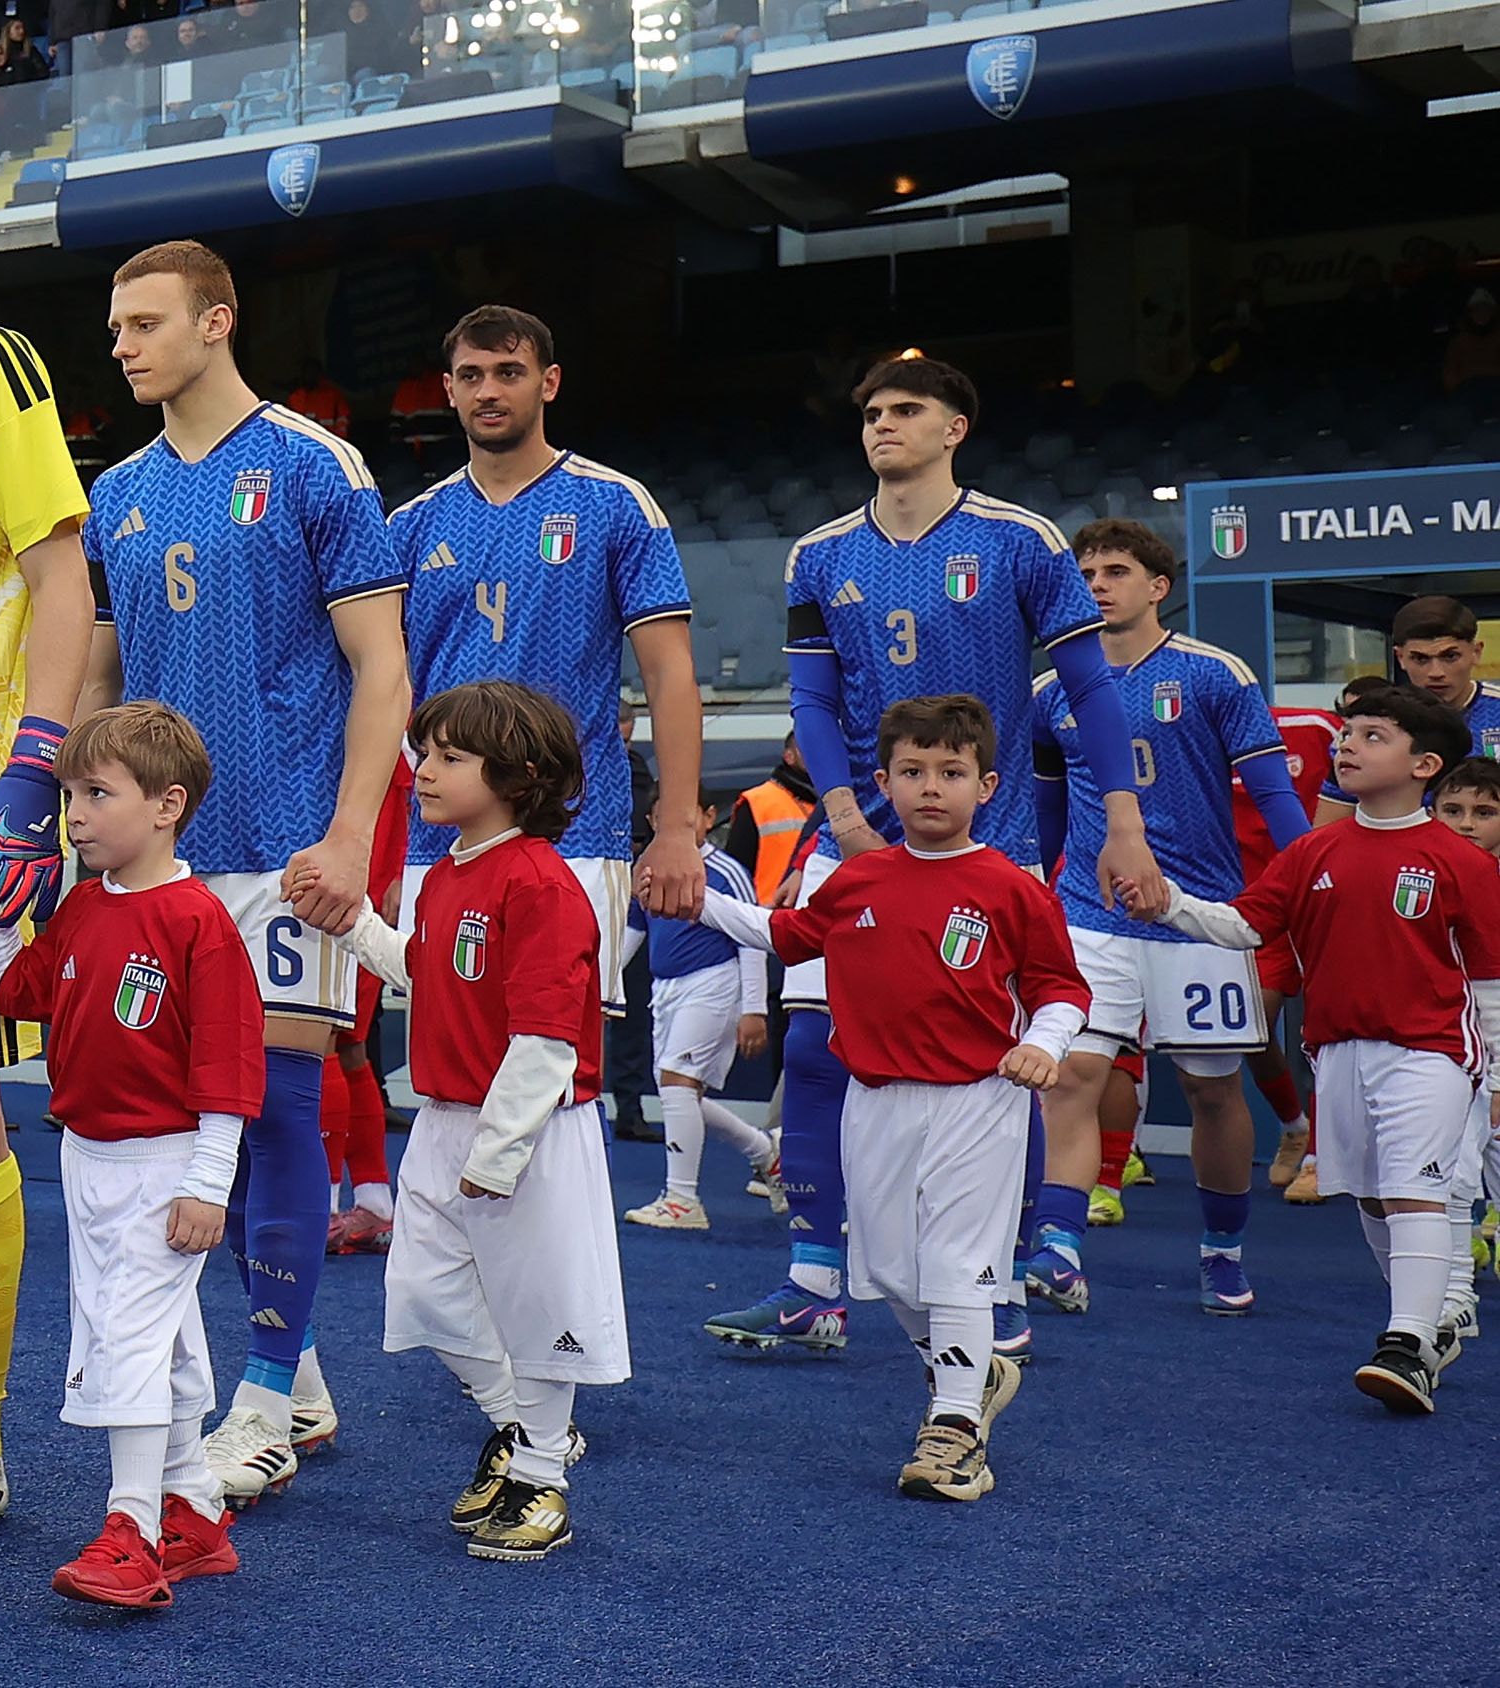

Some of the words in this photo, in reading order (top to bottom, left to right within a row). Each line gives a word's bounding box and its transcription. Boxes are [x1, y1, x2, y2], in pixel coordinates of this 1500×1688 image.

[237, 480, 267, 490] ITALIA
[1280, 504, 1414, 542] ITALIA
[164, 541, 197, 612] 6
[475, 582, 506, 643] 4
[886, 608, 918, 665] 3
[1401, 876, 1431, 889] ITALIA
[460, 923, 485, 939] ITALIA
[951, 917, 984, 936] ITALIA
[266, 915, 303, 988] 6
[126, 967, 162, 989] ITALIA
[1184, 982, 1247, 1031] 20
